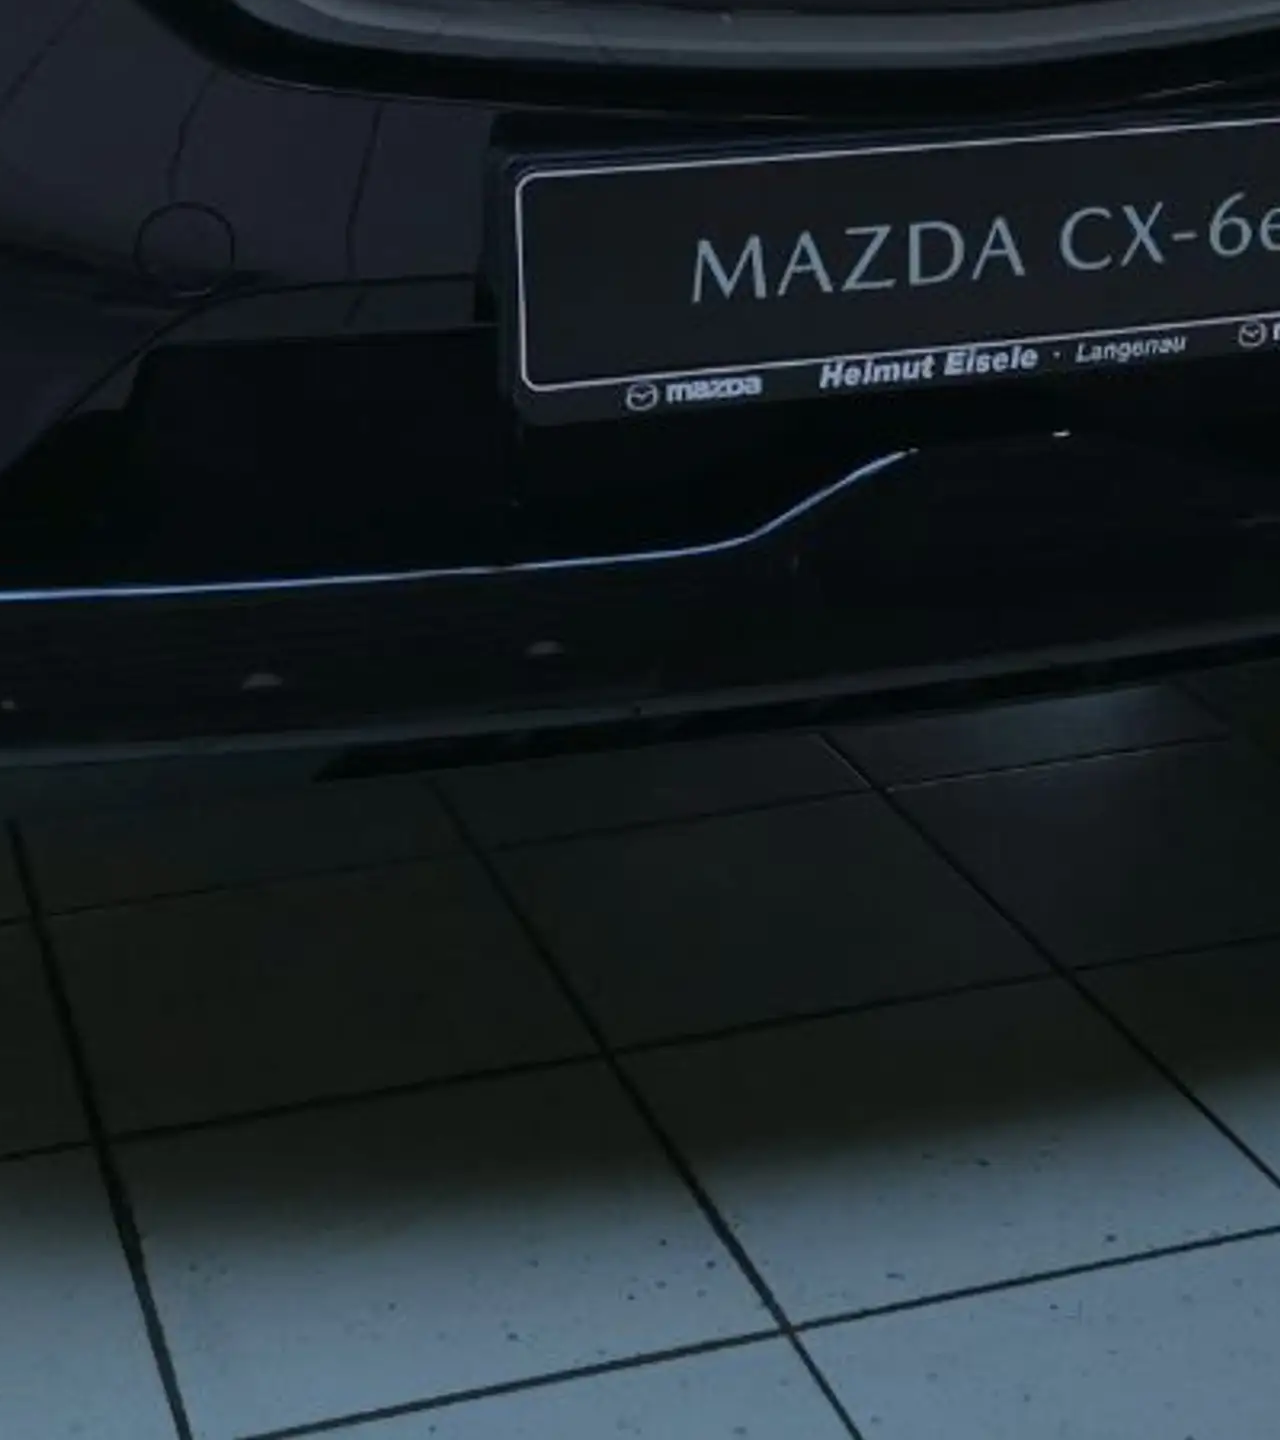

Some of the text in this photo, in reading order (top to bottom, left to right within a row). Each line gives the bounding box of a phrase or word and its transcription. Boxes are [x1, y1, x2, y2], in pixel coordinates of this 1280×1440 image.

[692, 216, 1025, 303] MAZDA
[664, 373, 761, 403] mazda
[818, 336, 1188, 389] Helmut Eisele Langenau
